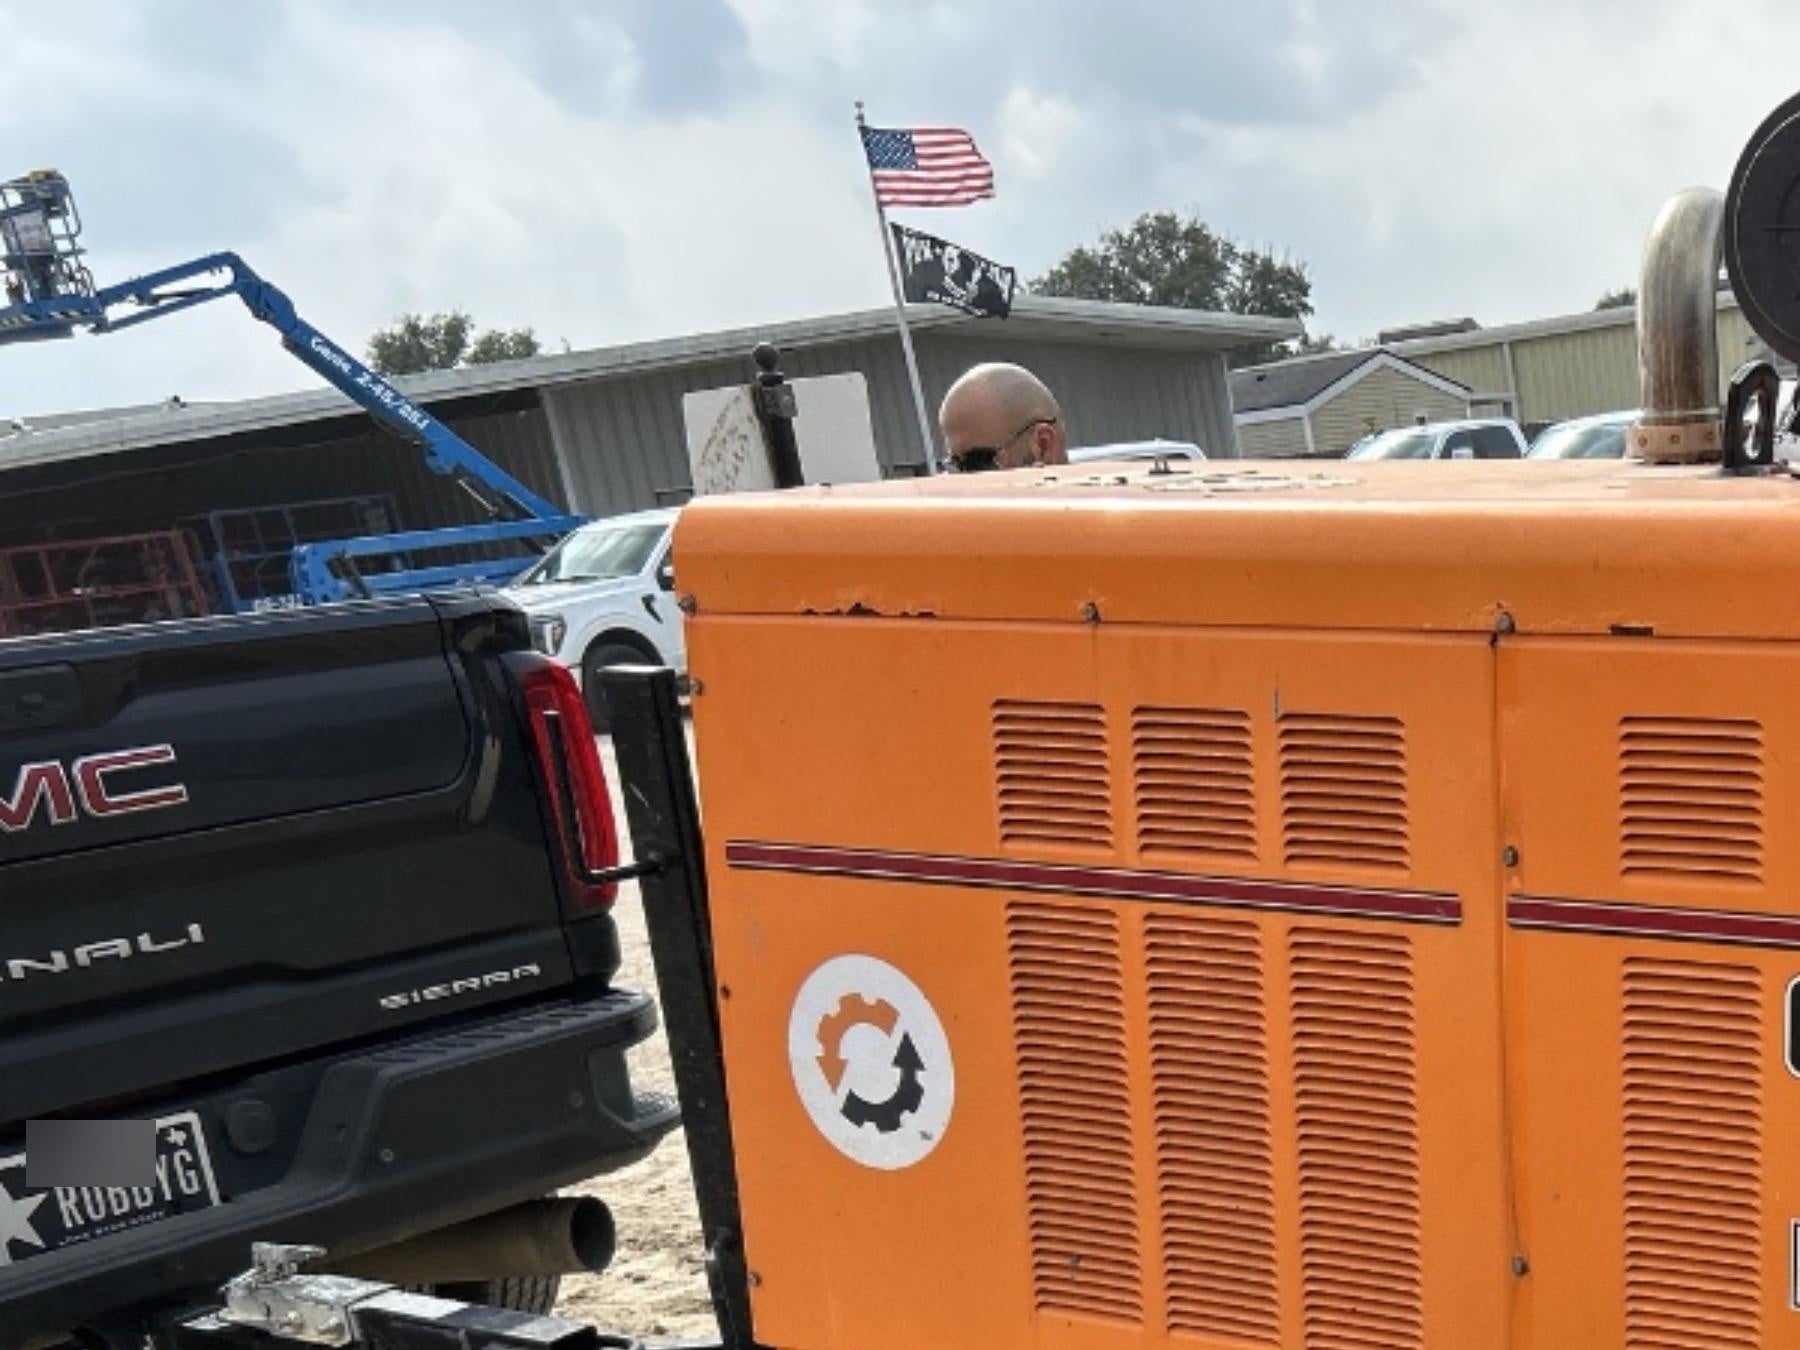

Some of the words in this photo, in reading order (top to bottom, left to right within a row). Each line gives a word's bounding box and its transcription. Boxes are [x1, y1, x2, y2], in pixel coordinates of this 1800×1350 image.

[0, 743, 188, 832] MC
[0, 923, 204, 982] NALI
[379, 962, 541, 1010] SIERRA
